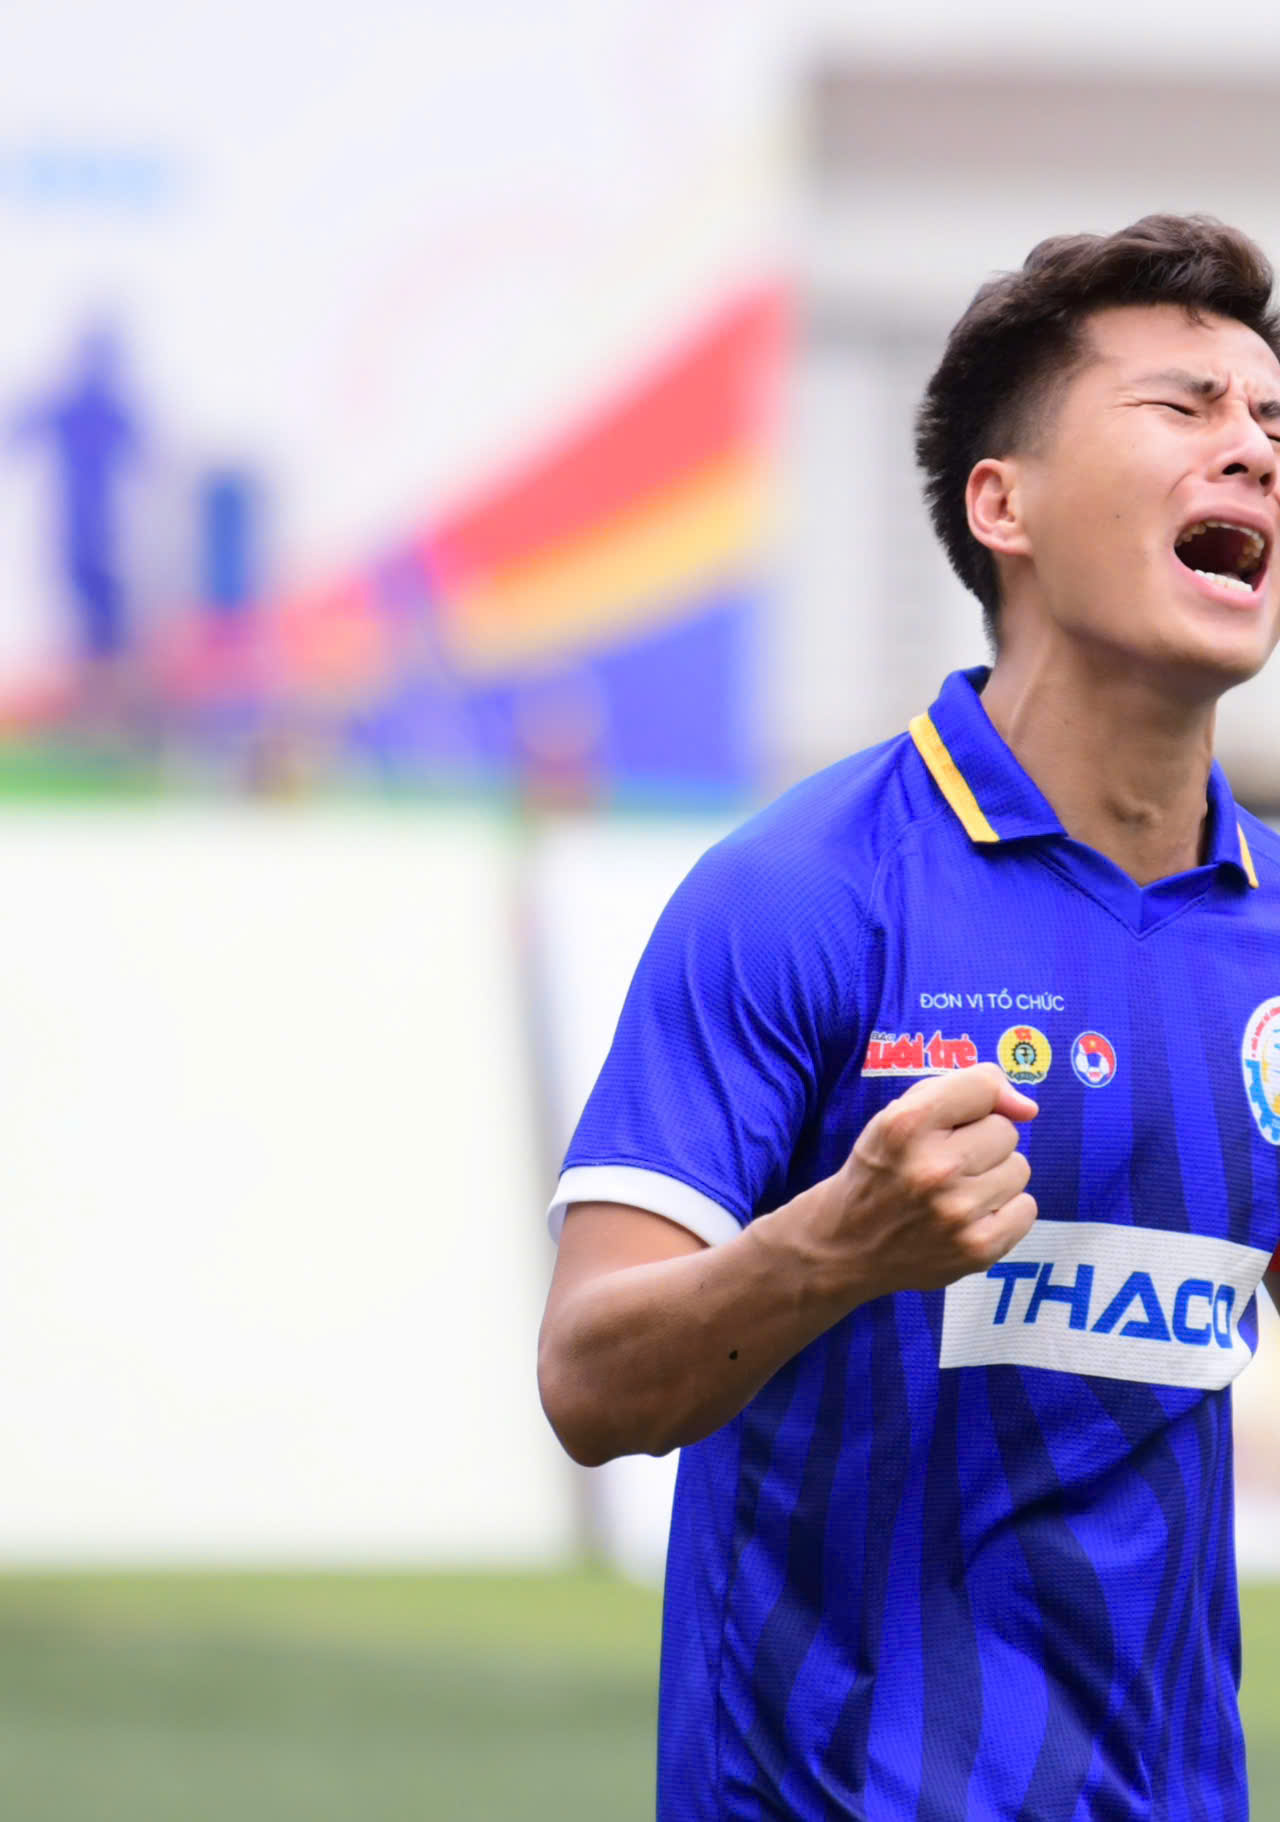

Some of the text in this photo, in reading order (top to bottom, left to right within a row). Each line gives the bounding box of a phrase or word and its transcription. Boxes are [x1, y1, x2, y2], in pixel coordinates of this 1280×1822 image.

[920, 992, 962, 1009] ĐƠN
[966, 993, 984, 1012] VỊ
[1016, 991, 1065, 1011] CHỨC
[986, 1261, 1236, 1349] THACO
